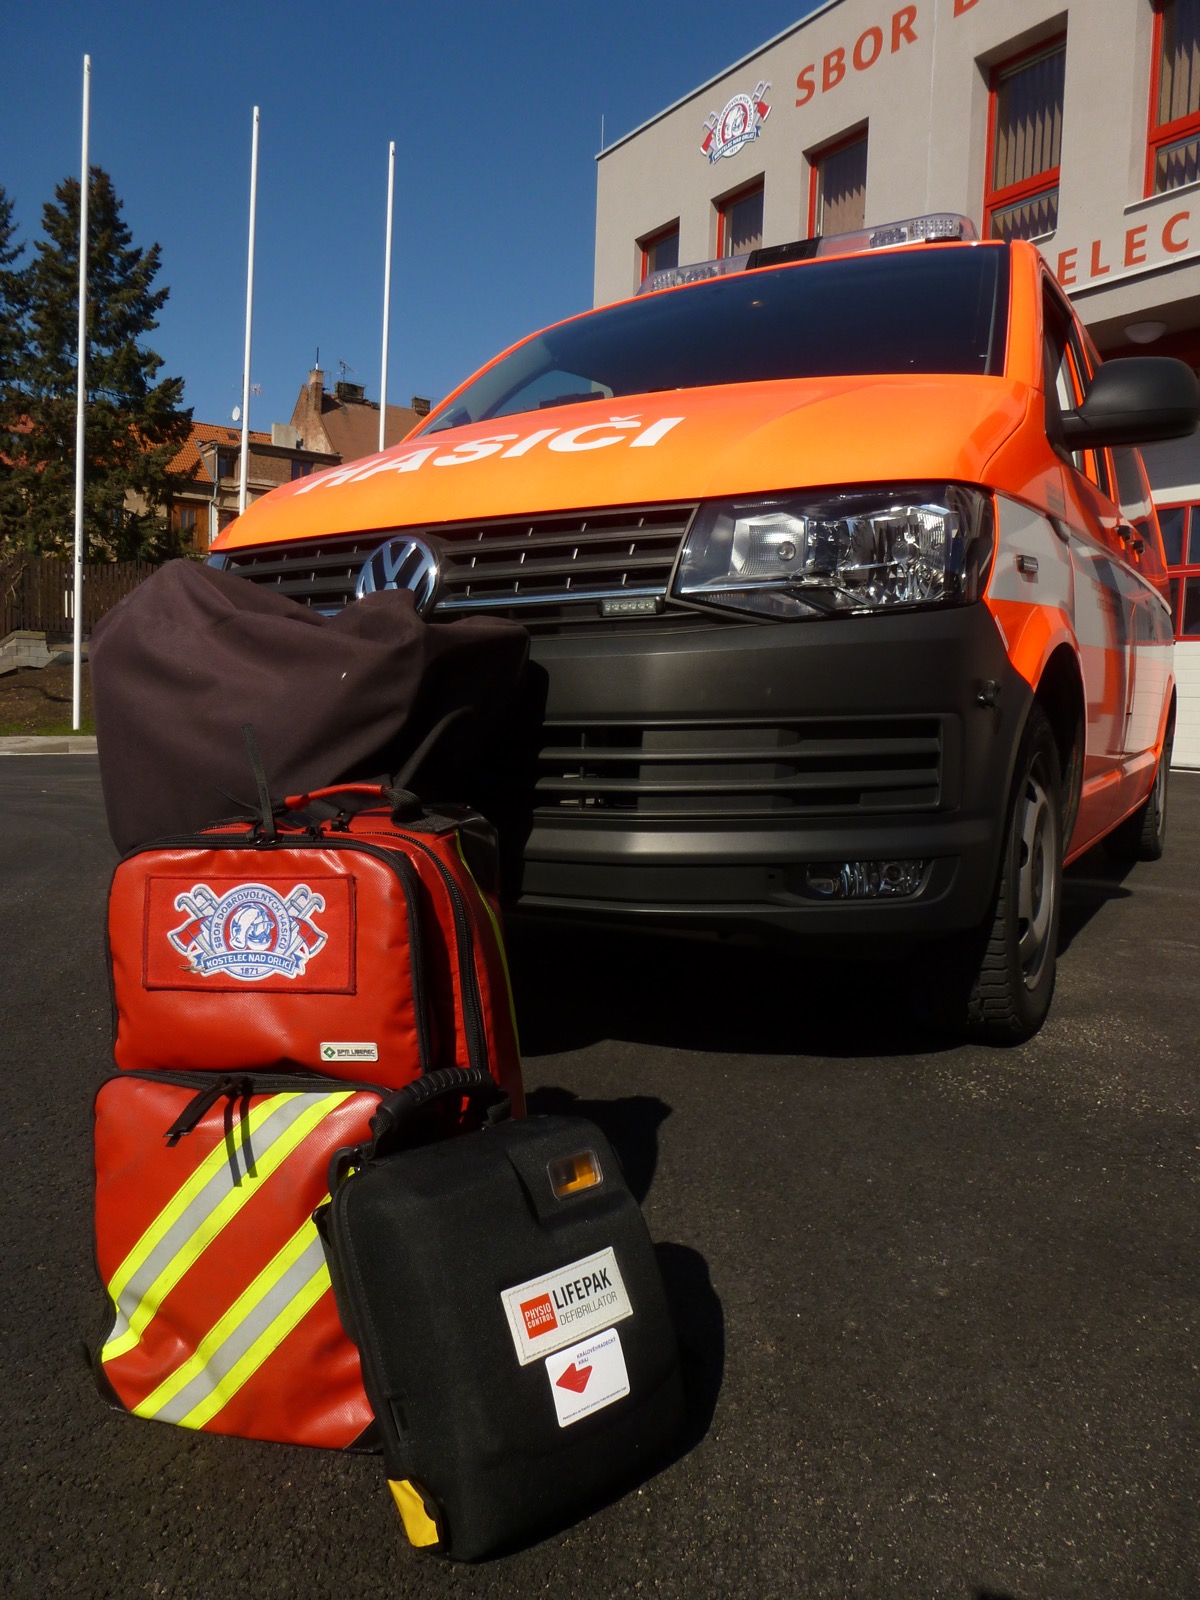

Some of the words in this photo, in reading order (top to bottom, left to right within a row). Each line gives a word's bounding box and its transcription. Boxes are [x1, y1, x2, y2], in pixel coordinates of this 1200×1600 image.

[795, 5, 919, 108] SBOR
[294, 414, 685, 496] HASIČI
[213, 922, 222, 949] SBOR
[206, 954, 247, 968] KOSTELEC
[248, 953, 266, 963] NAD
[240, 967, 260, 975] 1871
[552, 1267, 612, 1310] LIFEPAK
[524, 1302, 552, 1322] PHYSIO
[527, 1312, 554, 1329] CONTROL
[559, 1291, 618, 1326] DEFIBRILLATOR
